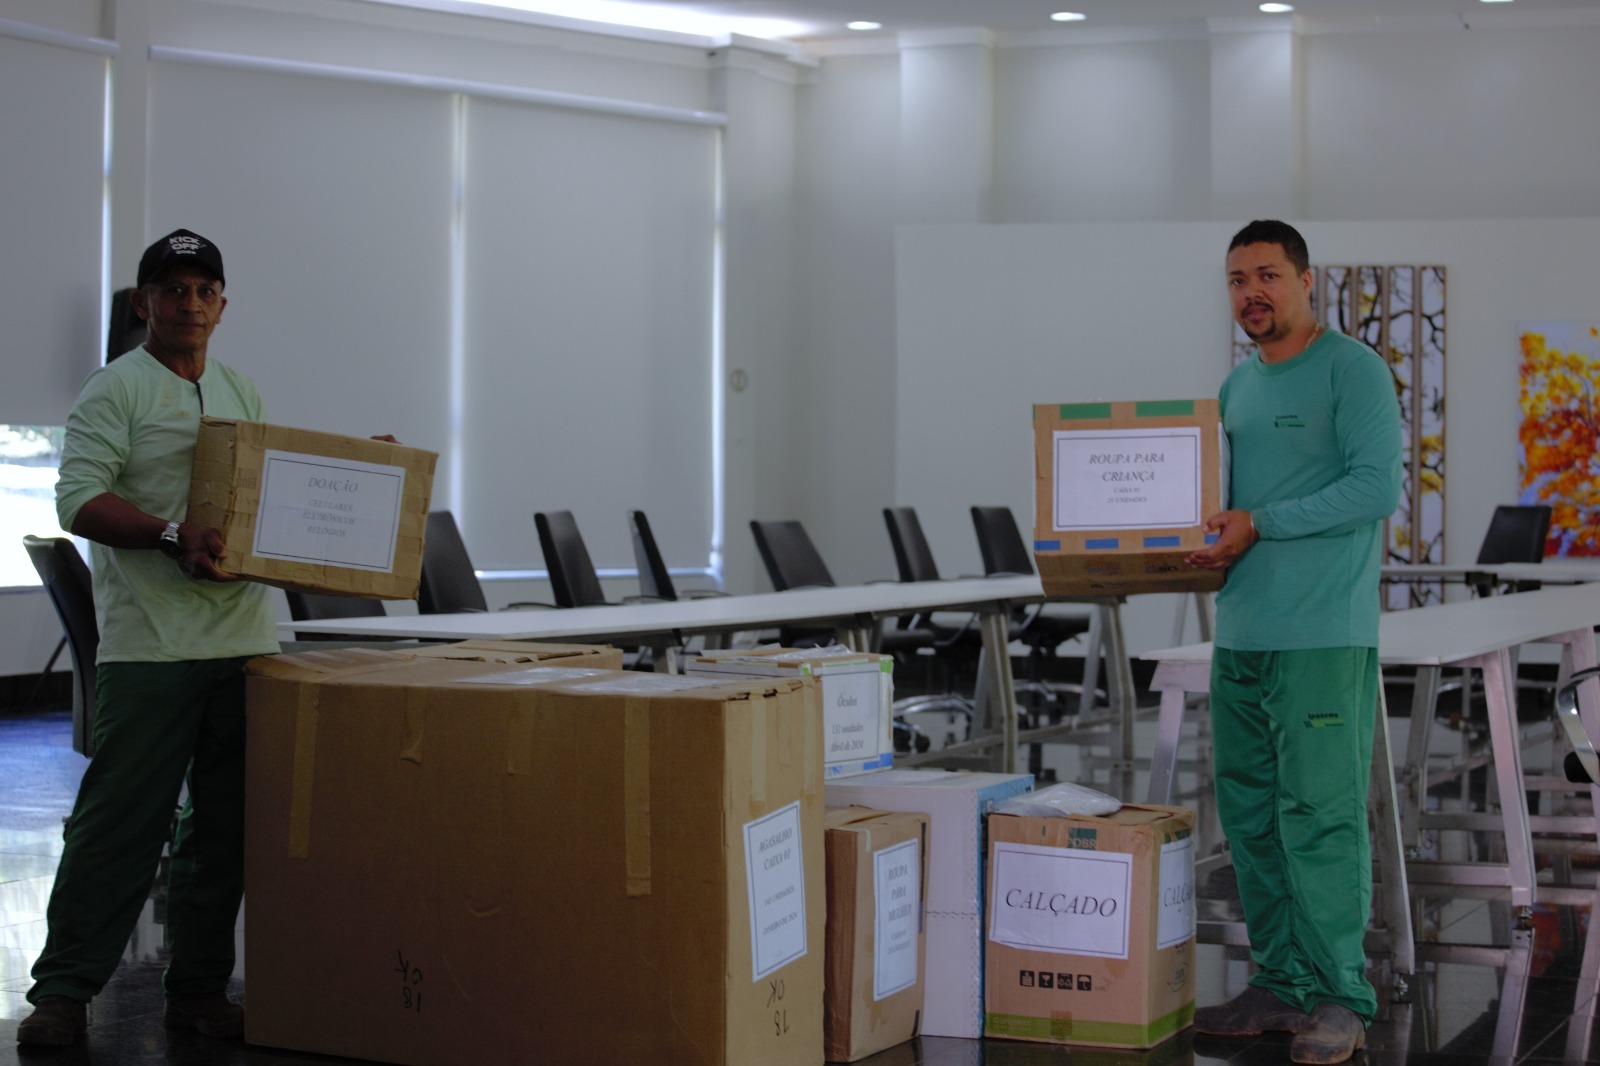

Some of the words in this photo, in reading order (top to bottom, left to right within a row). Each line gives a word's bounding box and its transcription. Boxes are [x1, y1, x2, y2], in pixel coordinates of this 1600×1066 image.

[168, 235, 200, 245] KICK
[1088, 453, 1131, 465] ROUPA
[1133, 452, 1165, 464] PARA
[1101, 470, 1155, 483] CRIANÇA
[308, 477, 358, 493] DOAÇÃO
[836, 692, 858, 708] Óculos
[758, 827, 793, 853] AGASALHO
[763, 852, 783, 872] CAIXA
[887, 864, 909, 881] ROUPA
[890, 885, 907, 901] PARA
[1005, 888, 1118, 917] CALÇADO
[766, 979, 785, 1008] OK
